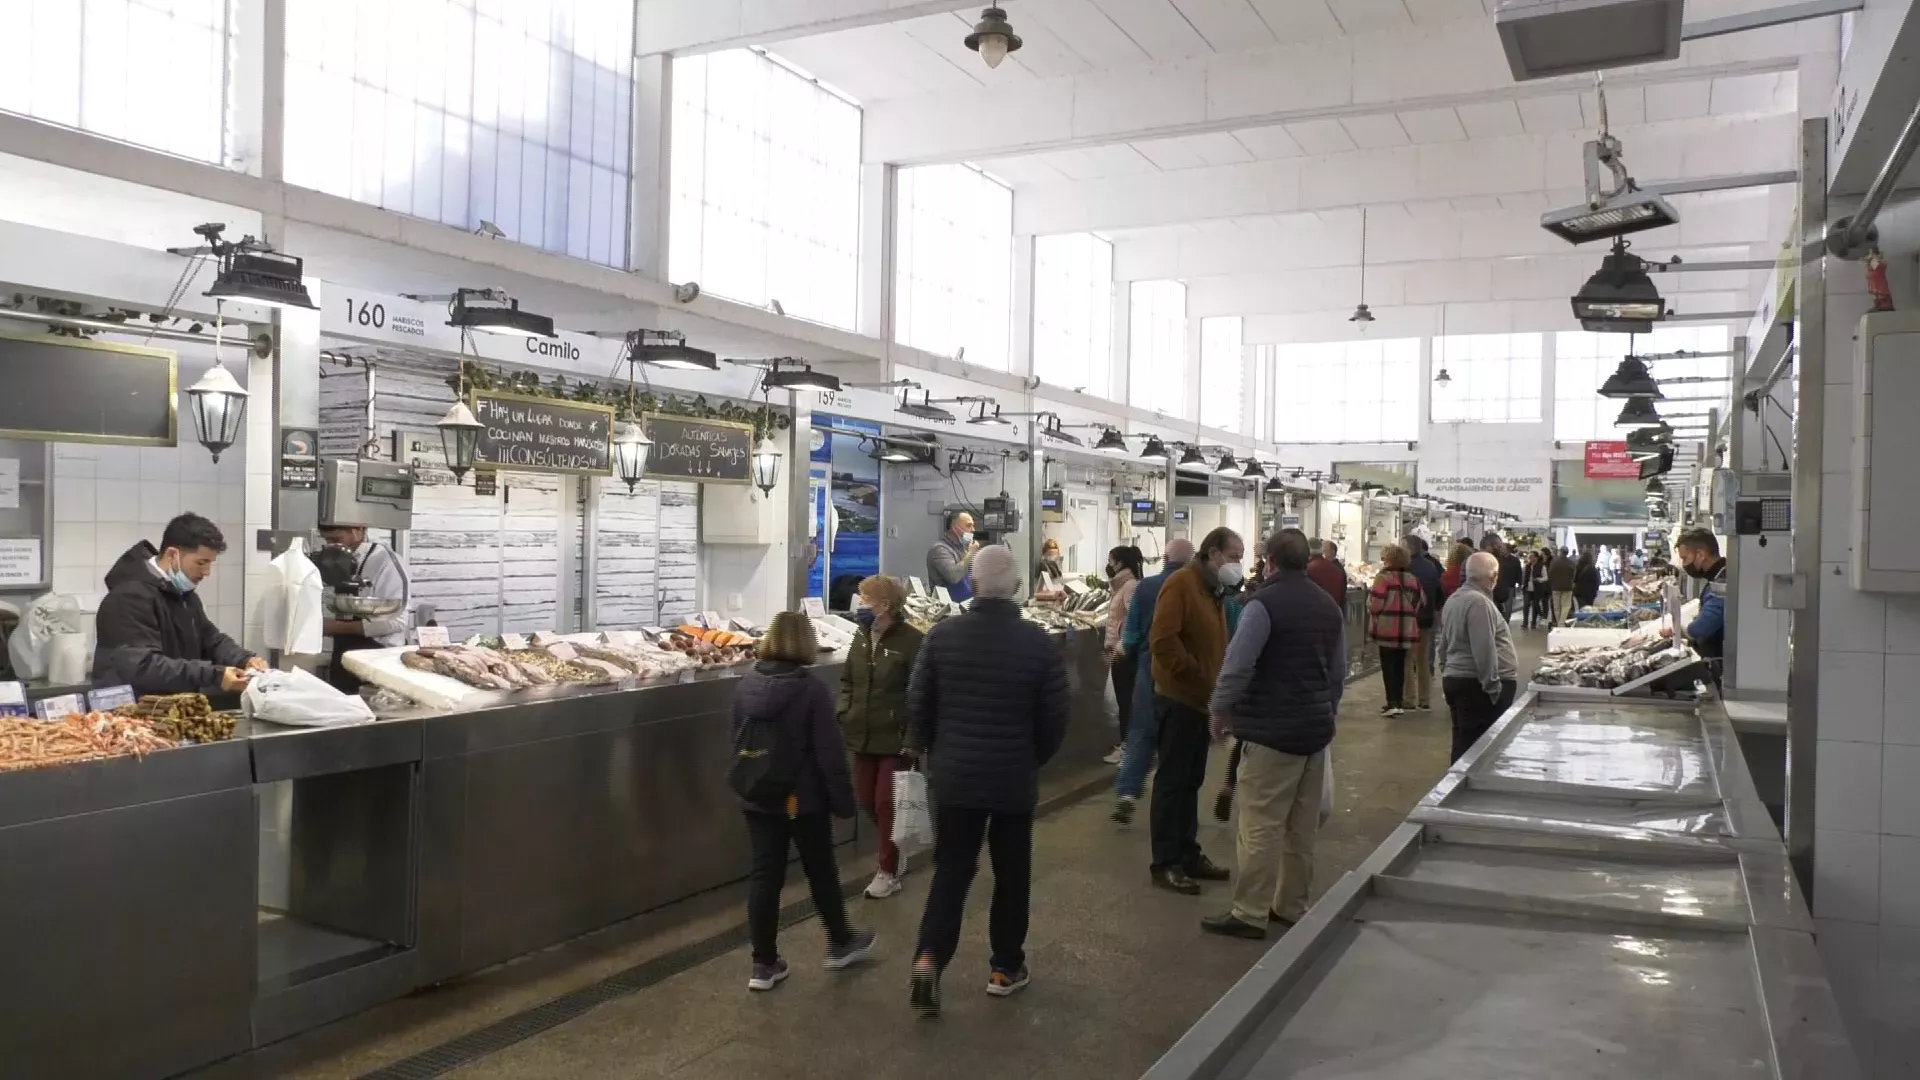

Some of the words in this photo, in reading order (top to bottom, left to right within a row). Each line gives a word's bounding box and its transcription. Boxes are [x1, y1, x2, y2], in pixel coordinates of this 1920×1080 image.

[346, 298, 385, 329] 160
[392, 316, 424, 328] MARISCOS
[392, 324, 424, 336] PESCADOS
[526, 336, 580, 360] Camilo
[818, 391, 835, 406] 159
[487, 427, 533, 442] COCINAN
